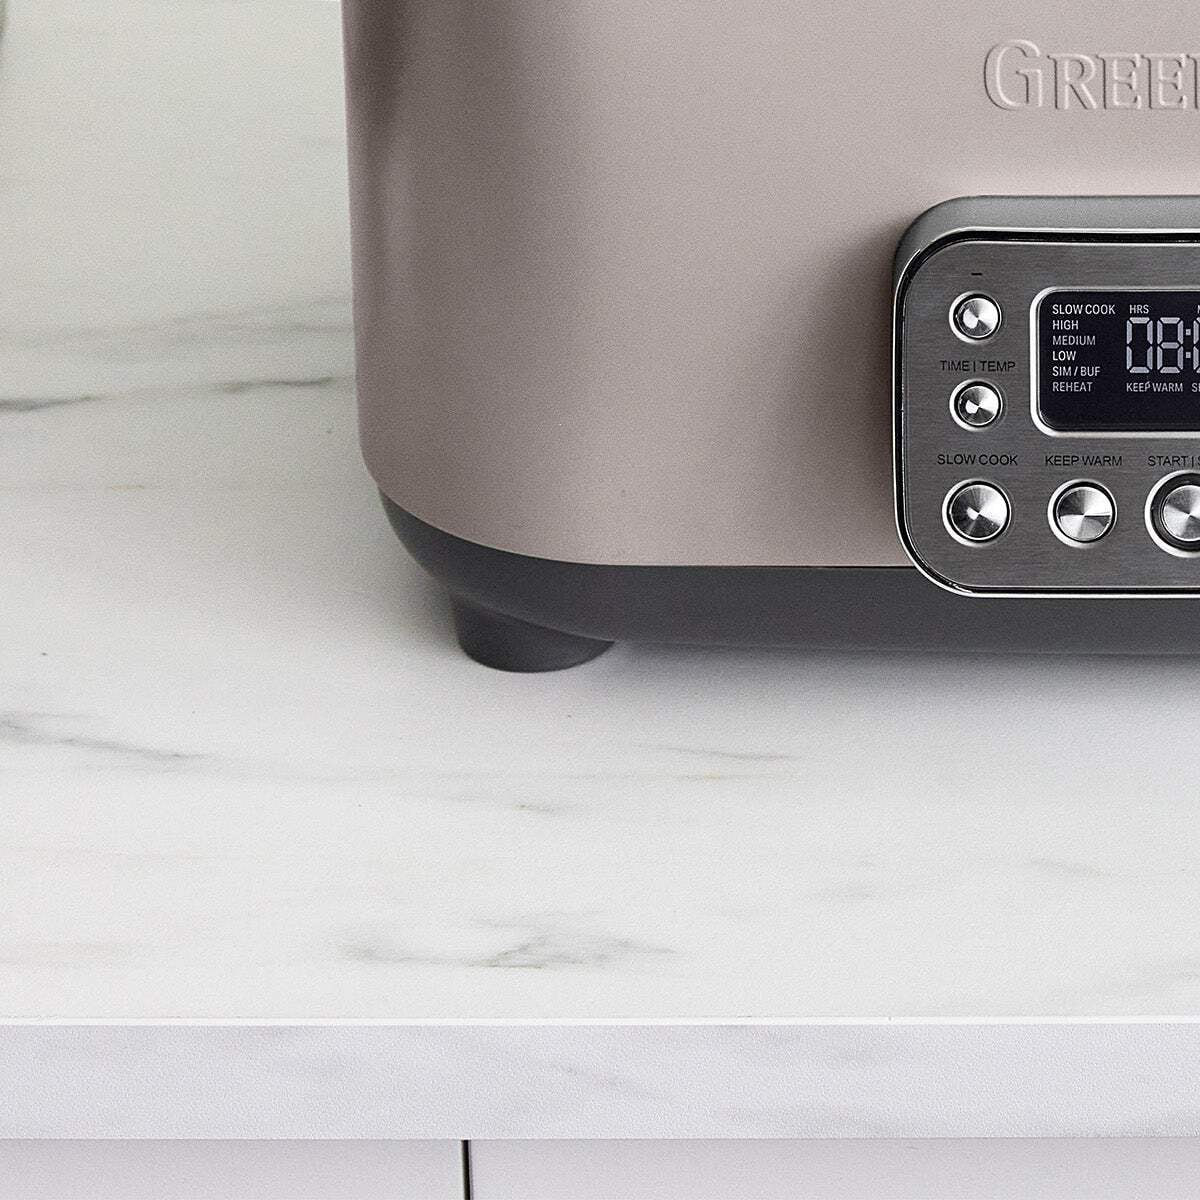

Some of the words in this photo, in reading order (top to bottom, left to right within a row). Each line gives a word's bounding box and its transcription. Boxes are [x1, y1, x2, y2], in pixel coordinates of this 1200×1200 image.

[1052, 304, 1085, 314] SLOW
[1085, 304, 1116, 314] COOK
[1129, 304, 1150, 314] HRS
[1052, 320, 1079, 330] HIGH
[1052, 335, 1096, 345] MEDIUM
[1052, 351, 1077, 361] LOW
[940, 360, 969, 371] TIME
[979, 360, 1016, 372] TEMP
[1052, 366, 1072, 376] SIM
[1079, 366, 1101, 376] BUF
[1052, 382, 1093, 392] REHEAT
[1126, 381, 1151, 392] KEEP
[1152, 382, 1184, 392] WARM
[937, 453, 977, 466] SLOW
[977, 453, 1019, 466] COOK
[1045, 454, 1079, 466] KEEP
[1081, 454, 1123, 466] WARM
[1147, 454, 1188, 466] START
